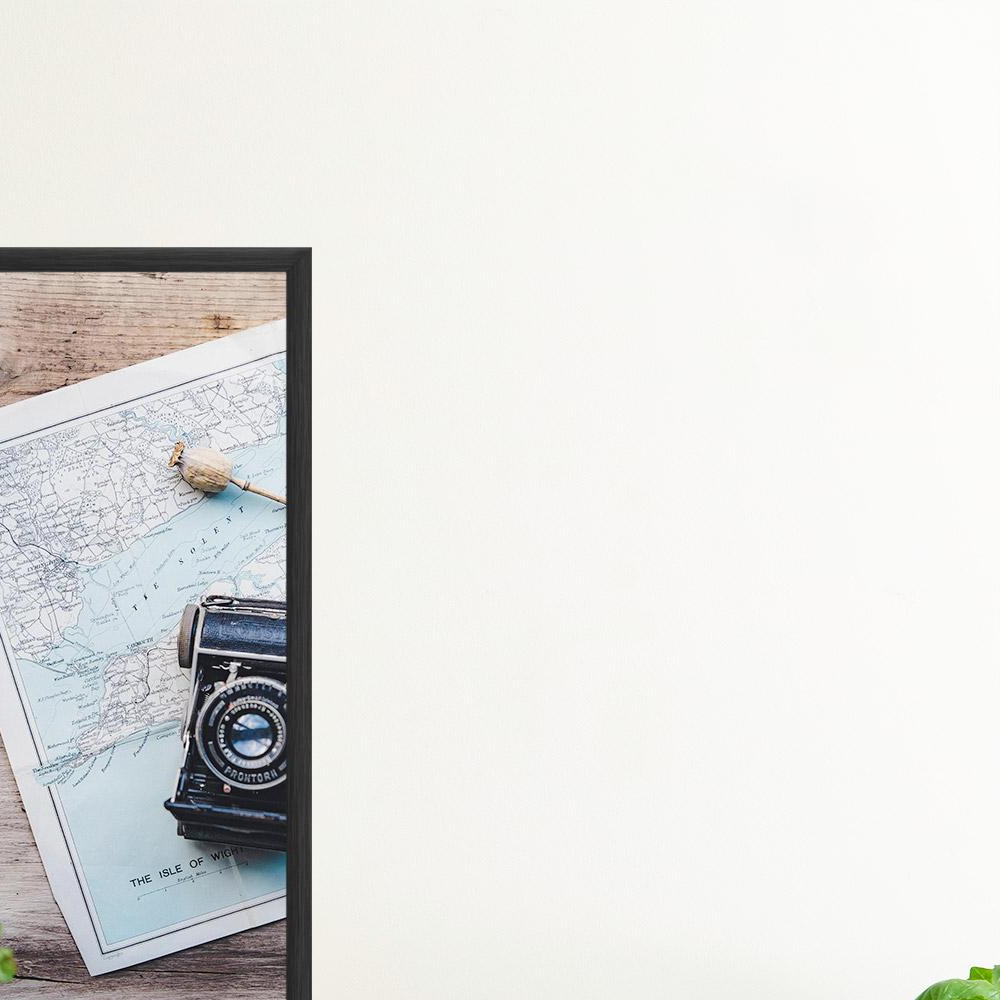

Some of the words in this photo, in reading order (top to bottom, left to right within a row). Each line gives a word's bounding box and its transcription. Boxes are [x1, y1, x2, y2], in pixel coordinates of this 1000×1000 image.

[129, 873, 153, 888] THE
[159, 864, 183, 879] ISLE
[189, 857, 205, 869] OF
